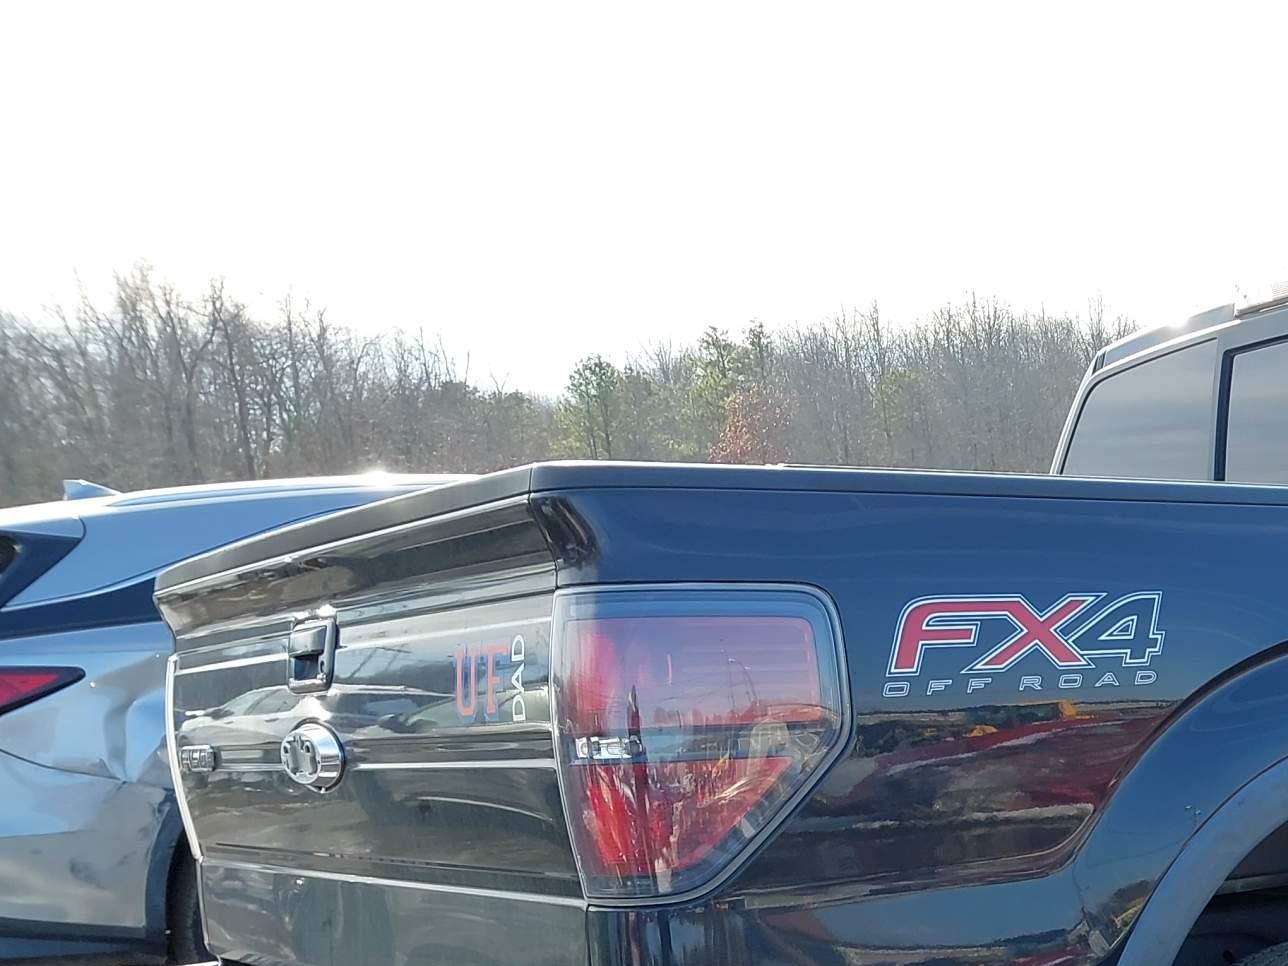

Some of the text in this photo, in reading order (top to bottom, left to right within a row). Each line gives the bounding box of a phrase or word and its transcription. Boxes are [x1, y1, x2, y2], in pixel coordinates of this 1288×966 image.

[886, 591, 1166, 677] FX4
[511, 634, 526, 722] DAD
[883, 671, 1158, 697] OFF ROAD
